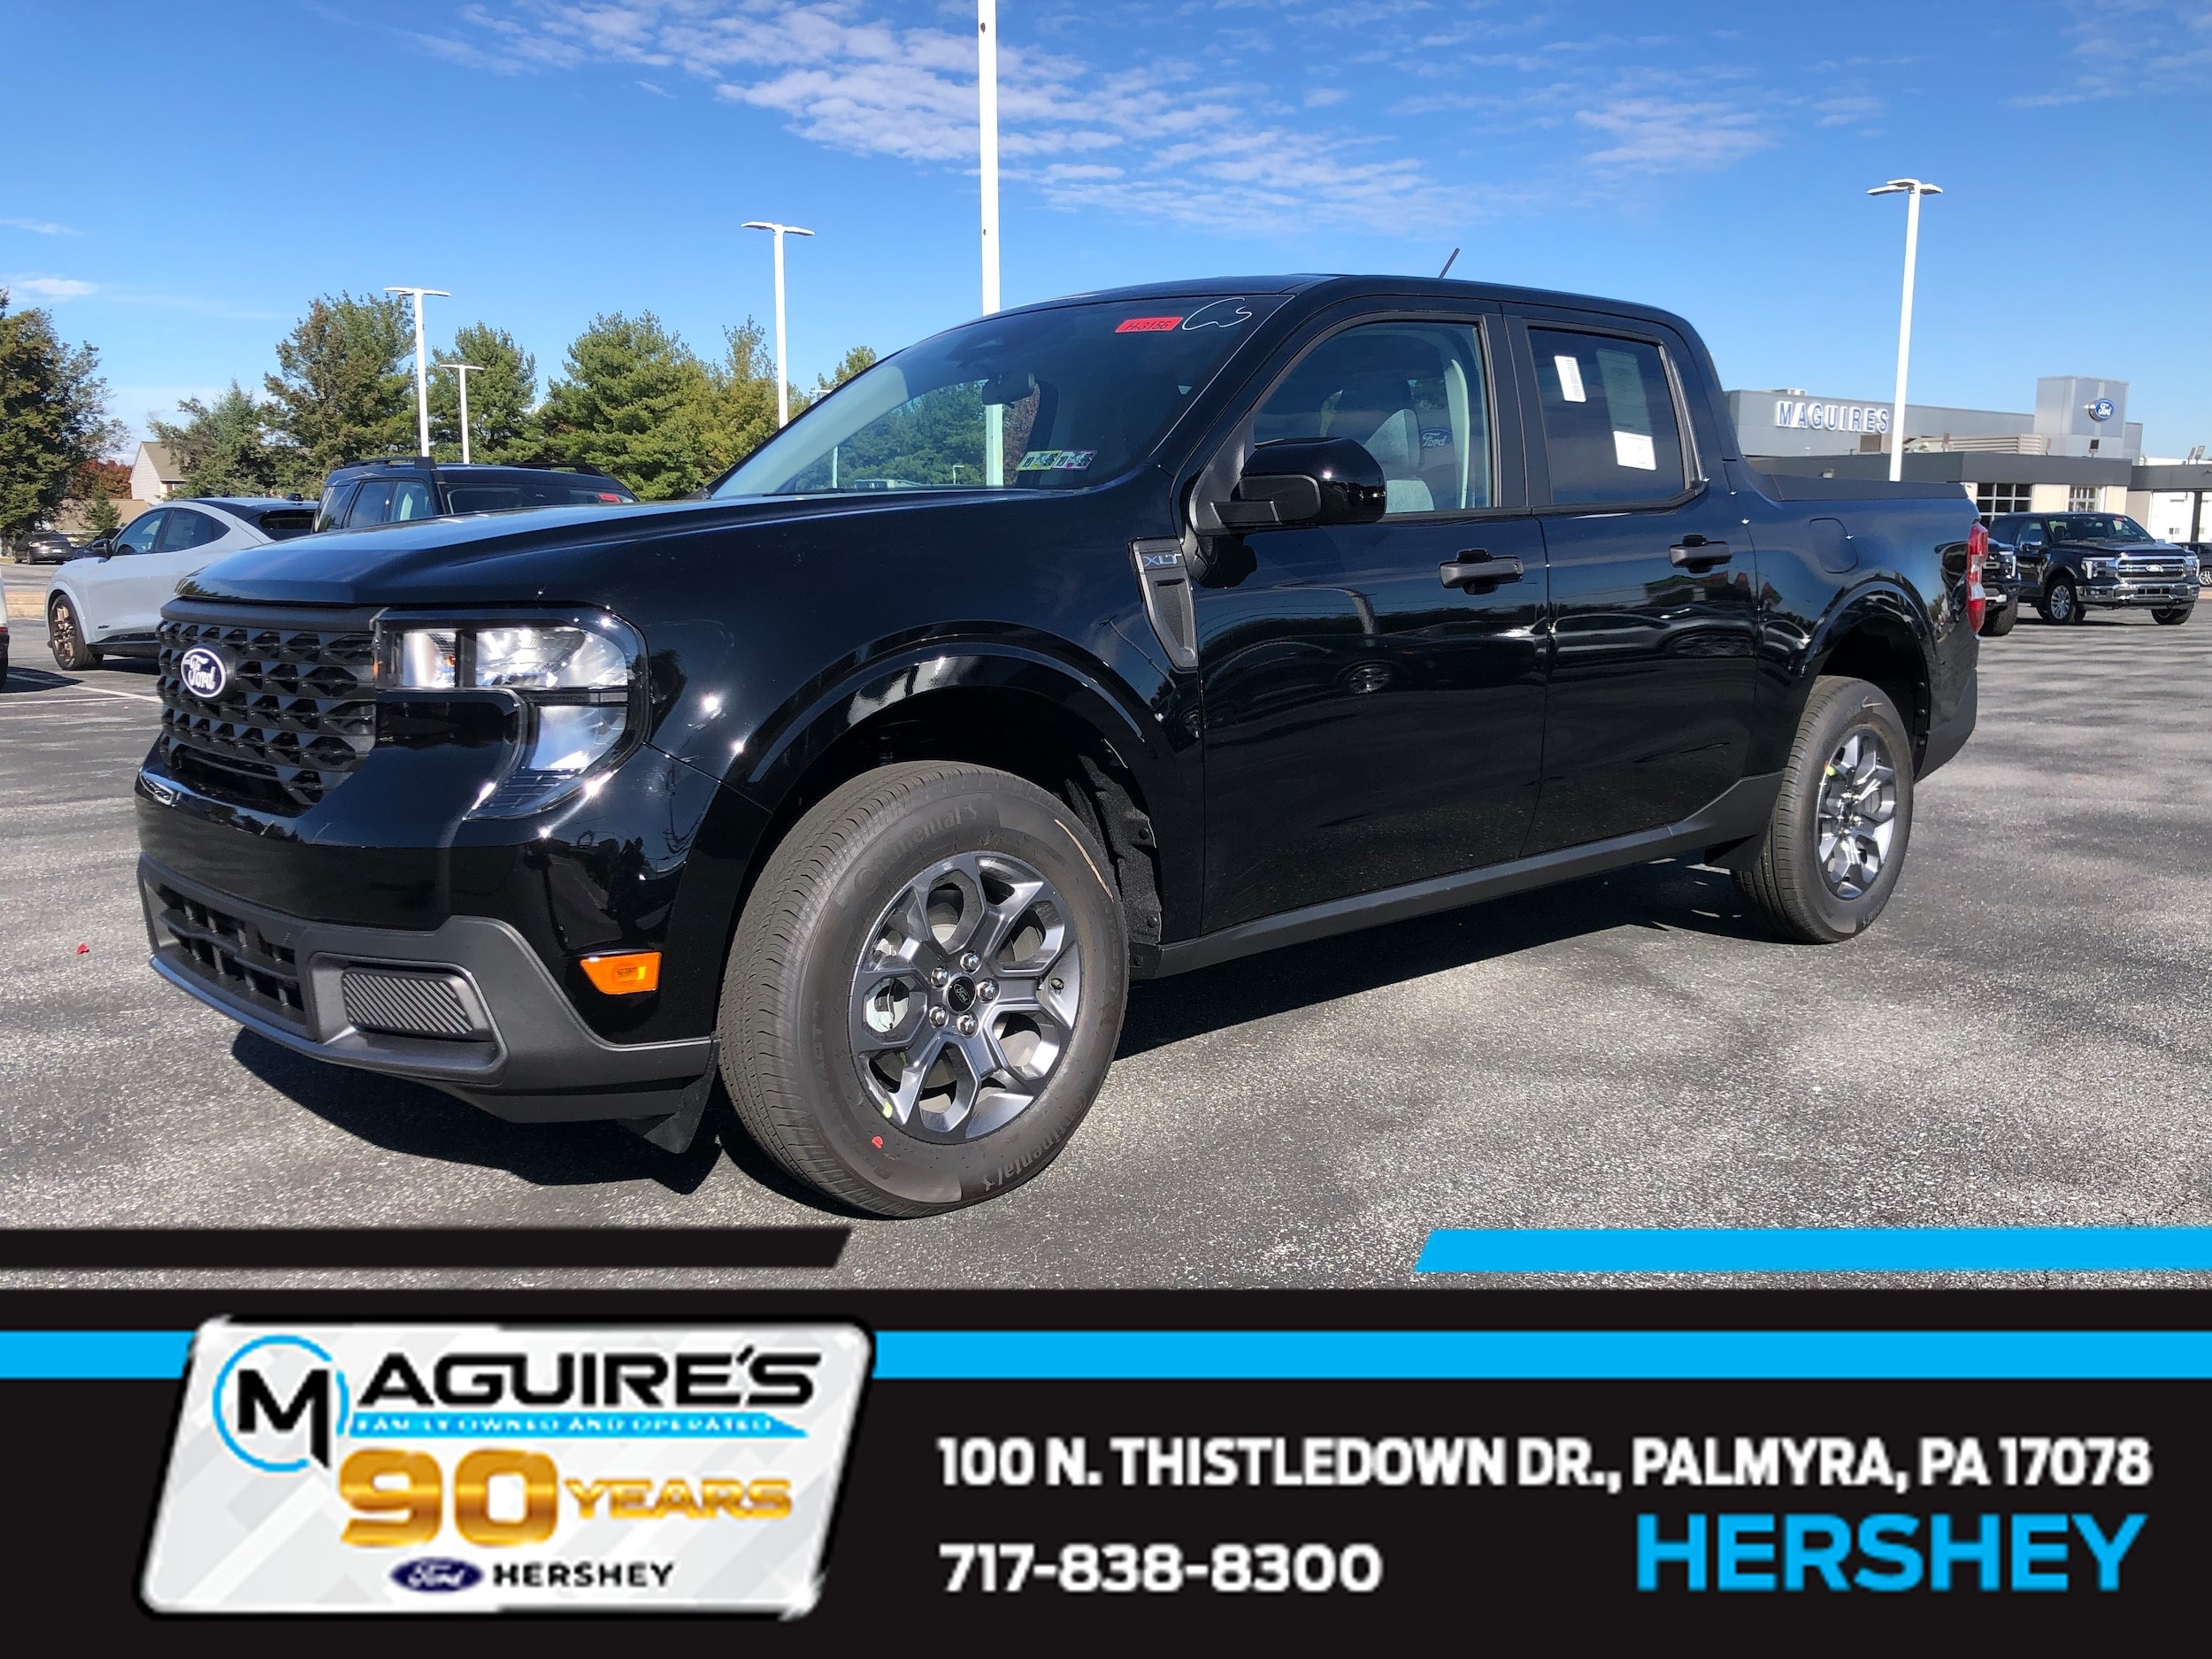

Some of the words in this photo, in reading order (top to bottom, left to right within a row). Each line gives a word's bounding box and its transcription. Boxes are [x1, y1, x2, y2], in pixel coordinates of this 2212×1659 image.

[1776, 401, 1889, 434] MAGUIRES
[1423, 432, 1448, 447] Ford
[1143, 553, 1182, 567] XLT
[183, 654, 217, 690] Ford
